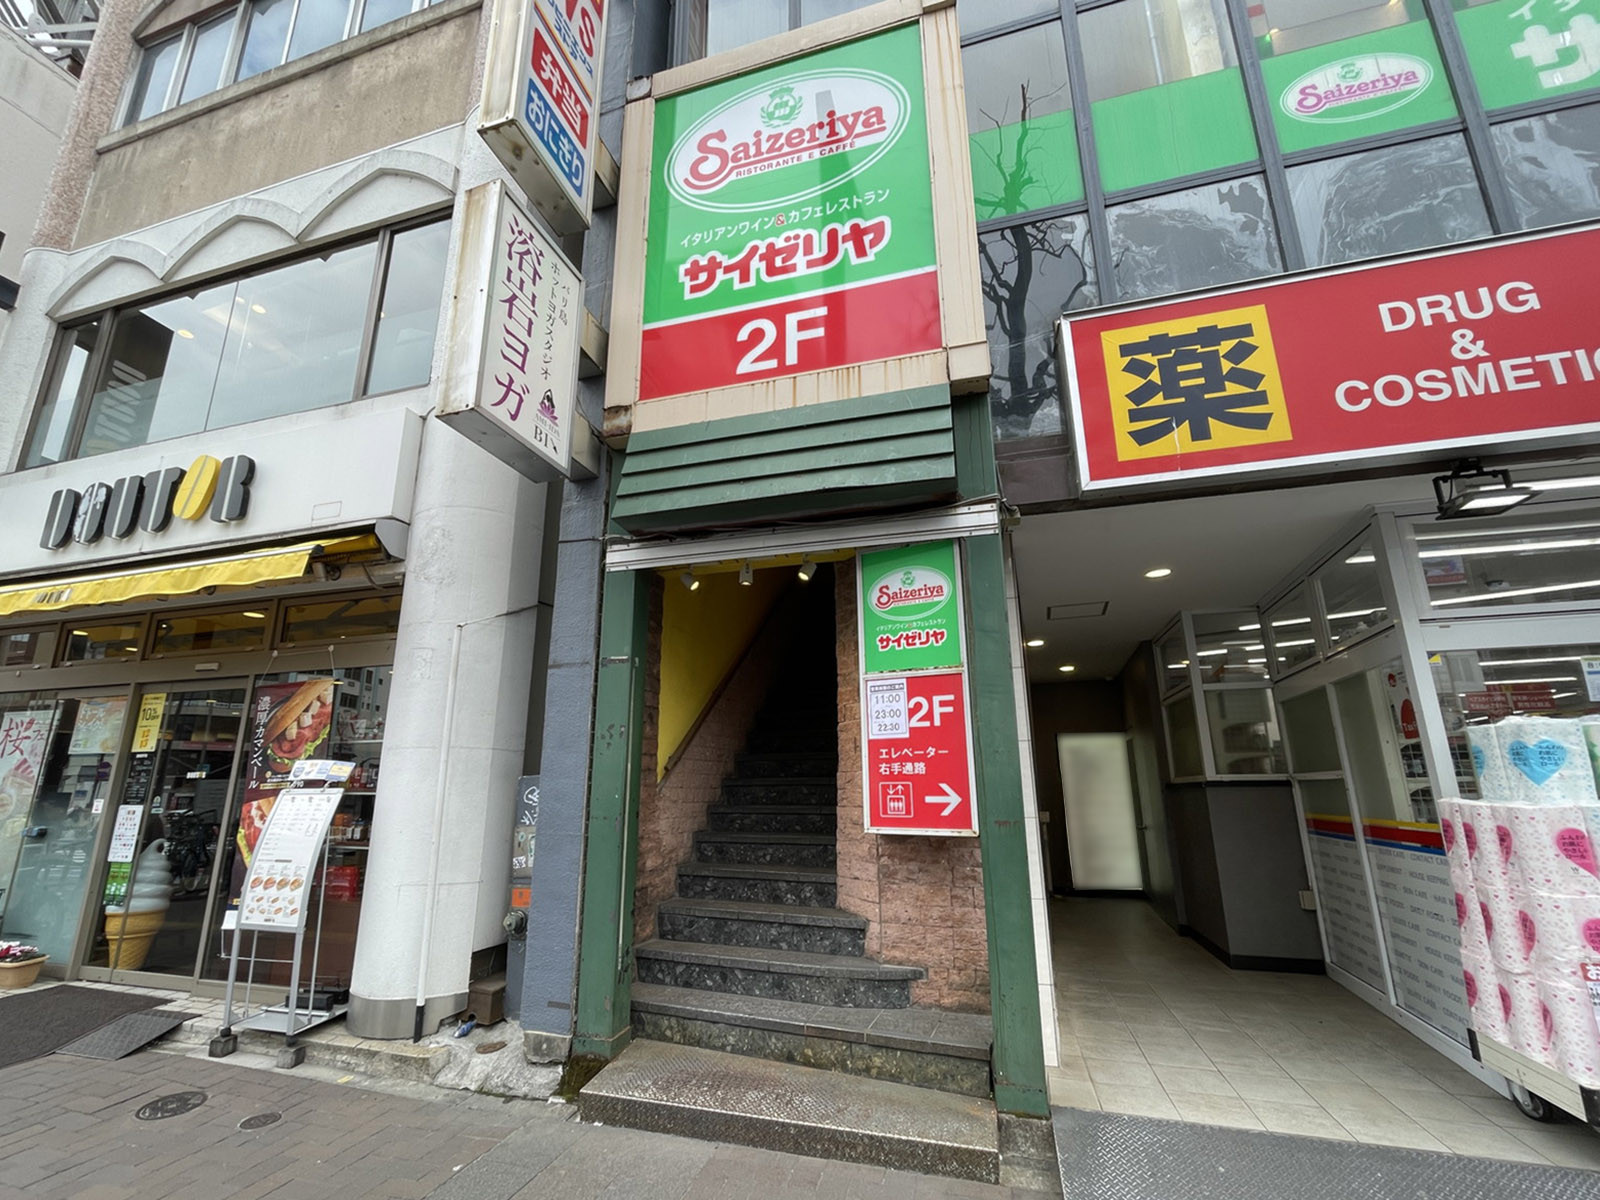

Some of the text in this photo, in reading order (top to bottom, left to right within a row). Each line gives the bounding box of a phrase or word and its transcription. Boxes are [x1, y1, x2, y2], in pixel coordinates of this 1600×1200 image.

[540, 51, 583, 135] 弁当
[1294, 70, 1419, 114] Saizeriya
[528, 88, 583, 186] おにぎり
[683, 104, 886, 190] Saizeriya
[735, 154, 803, 178] RISTORANTE
[808, 151, 815, 160] E
[680, 217, 889, 298] サイゼリヤ
[490, 212, 545, 422] 溶岩ヨガ
[1378, 280, 1541, 334] DRUG
[735, 305, 829, 375] 2F
[1451, 328, 1488, 361] &
[1118, 322, 1274, 447] 薬
[41, 455, 255, 550] DOUTOR
[875, 584, 944, 609] Saizeriya
[877, 629, 946, 650] サイゼリヤ
[874, 708, 902, 719] 23:00
[875, 693, 901, 705] 11:00
[908, 694, 955, 728] 2F
[248, 696, 271, 790] 濃厚カマンベール
[879, 746, 949, 760] エレベーター
[878, 761, 927, 776] 右手通路
